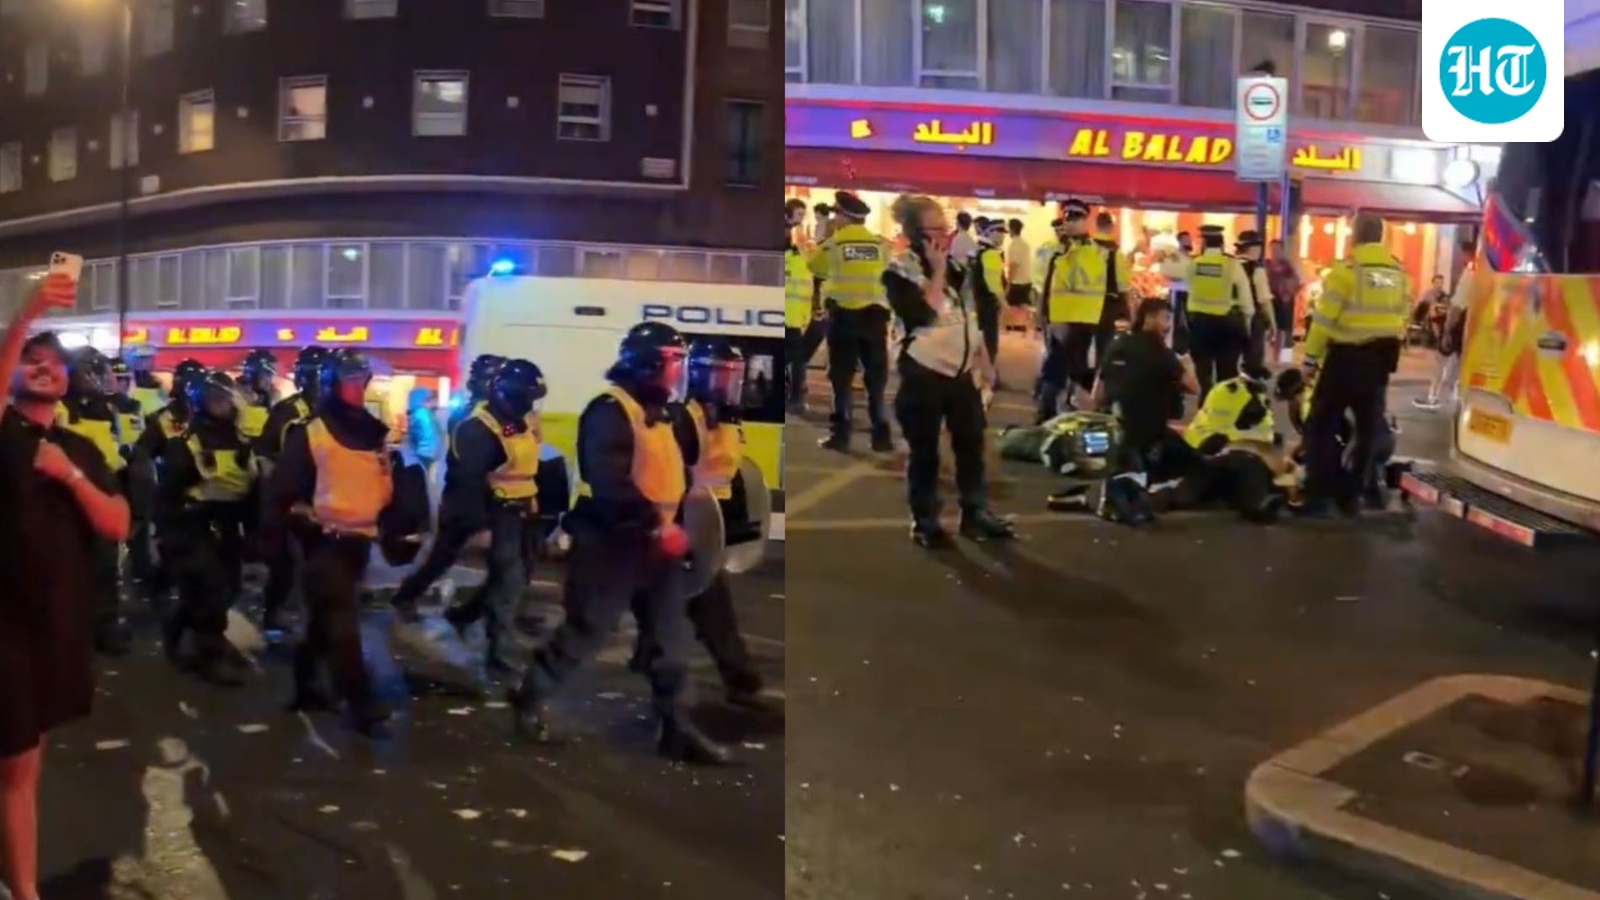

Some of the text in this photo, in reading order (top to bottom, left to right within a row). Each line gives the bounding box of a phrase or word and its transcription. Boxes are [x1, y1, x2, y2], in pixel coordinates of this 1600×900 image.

[1069, 128, 1110, 156] AL
[1122, 131, 1232, 164] BALAD
[642, 304, 784, 326] POLIC
